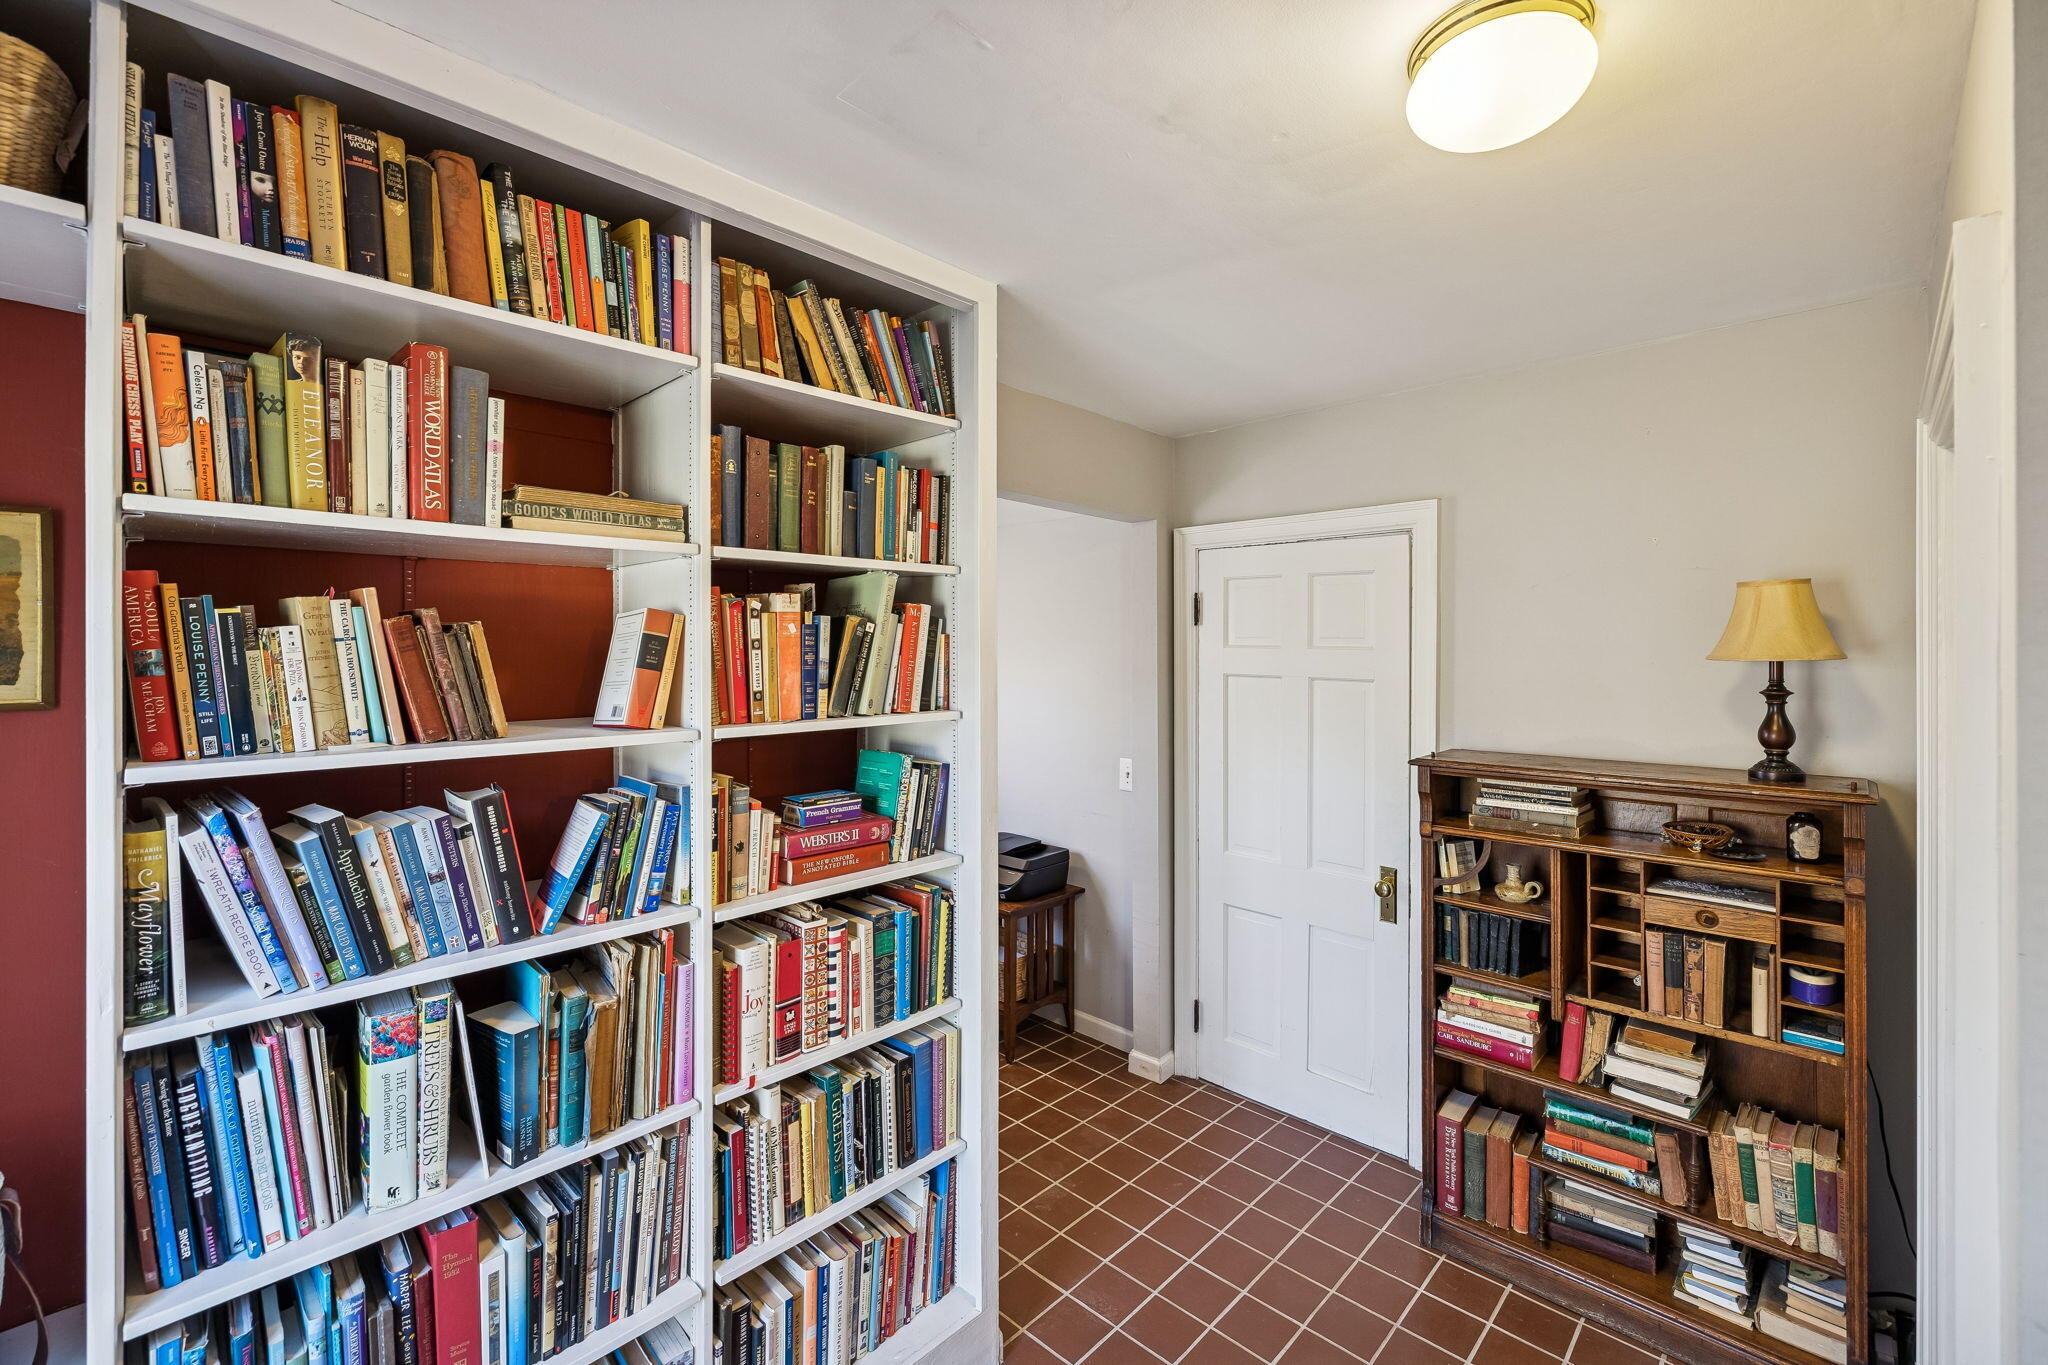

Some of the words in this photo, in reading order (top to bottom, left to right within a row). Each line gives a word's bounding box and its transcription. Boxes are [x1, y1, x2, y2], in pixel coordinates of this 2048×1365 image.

[126, 65, 137, 101] STUART
[126, 103, 137, 136] LITTLE
[254, 109, 264, 129] Joyce
[317, 116, 327, 133] The
[257, 131, 265, 149] Carol
[310, 132, 330, 167] Help
[344, 133, 377, 148] HERMAN
[349, 140, 375, 153] WOUK
[258, 151, 266, 170] Oates
[315, 178, 327, 231] STOCKETT
[324, 180, 334, 231] KATHRYN
[501, 199, 509, 218] THE
[506, 190, 515, 212] GIRL
[261, 208, 270, 247] Mudwoman
[502, 222, 514, 248] TRAIN
[543, 225, 553, 256] SCHWAB
[526, 233, 542, 281] CUMBERLANDS
[661, 245, 669, 278] LOUISE
[510, 260, 520, 295] HAWKINS
[663, 281, 671, 314] PENNY
[122, 326, 139, 383] BEGINNING
[833, 346, 847, 381] TYLER
[193, 364, 204, 395] Celeste
[128, 383, 142, 416] CHESS
[194, 397, 204, 411] Ng
[130, 417, 143, 444] PLAY
[303, 388, 323, 489] ELEANOR
[424, 400, 441, 458] WORLD
[424, 459, 441, 510] ATLAS
[514, 502, 567, 520] GOODE'S
[573, 507, 613, 525] WORLD
[618, 513, 652, 528] ATLAS
[124, 586, 144, 647] AMERICA
[167, 596, 177, 607] On
[303, 611, 330, 622] Grapes
[339, 602, 347, 615] THE
[909, 608, 920, 617] Me
[144, 600, 157, 637] SOUL
[169, 607, 182, 651] Grandma's
[307, 628, 332, 637] Wrath
[189, 615, 204, 659] LOUISE
[341, 617, 352, 656] CAROLINA
[908, 621, 917, 658] Katharine
[176, 651, 185, 673] Porch
[248, 654, 260, 691] Brendan
[295, 659, 304, 683] PLAYING
[195, 662, 211, 704] PENNY
[346, 657, 358, 701] HOUSEWIFE
[905, 659, 914, 697] Hepburn
[141, 681, 157, 733] MEACHAM
[151, 694, 165, 715] JON
[298, 721, 308, 748] GRISHAM
[594, 815, 606, 835] JOAN
[619, 807, 628, 827] KAREN
[670, 810, 679, 827] PAT
[805, 808, 830, 818] French
[830, 803, 862, 815] Grammar
[440, 820, 452, 841] MARY
[486, 805, 501, 845] MOONFLOWER
[494, 845, 507, 872] MURDERS
[614, 827, 623, 847] WHITE
[800, 831, 850, 850] WEBSTER'S
[851, 829, 859, 839] II
[127, 846, 164, 855] NATHANIEL
[128, 854, 163, 863] PHILBRICK
[445, 841, 459, 868] PETERS
[579, 837, 595, 865] DIDION
[662, 829, 675, 868] CONROY
[819, 859, 830, 867] NEW
[830, 854, 855, 864] OXFORD
[254, 828, 283, 886] SOUTHERN
[275, 882, 299, 925] BOUQUETS
[331, 822, 342, 846] WILLIAMS
[338, 848, 365, 909] Appalachia
[802, 863, 842, 875] ANNOTATED
[843, 858, 860, 867] BIBLE
[242, 890, 256, 908] The
[414, 886, 426, 901] MAN
[424, 844, 436, 867] LAMOTT
[439, 902, 452, 928] JONES
[328, 904, 341, 922] MAN
[418, 901, 433, 924] CALLED
[553, 888, 569, 918] NIGHTS
[131, 868, 162, 974] Mayflower
[209, 870, 234, 913] WREATH
[229, 912, 253, 948] RECIPE
[246, 949, 265, 978] BOOK
[247, 905, 267, 934] Scented
[300, 888, 318, 925] CHARLESTON
[315, 930, 330, 959] SAVANNAH
[334, 921, 349, 946] CALLED
[426, 925, 437, 940] OVE
[260, 932, 275, 955] Room
[342, 946, 355, 962] OVE
[742, 990, 765, 1015] joy
[423, 1025, 440, 1082] TREES
[1437, 1031, 1454, 1042] CARL
[1456, 1036, 1492, 1051] SANDBURG
[203, 1045, 216, 1091] SAMPLERS
[439, 1041, 447, 1072] HILLIER
[141, 1082, 150, 1097] THE
[158, 1077, 168, 1099] Sewing
[221, 1070, 230, 1094] COLOR
[381, 1073, 391, 1104] garden
[396, 1069, 407, 1091] THE
[143, 1098, 154, 1124] QUILTS
[177, 1083, 195, 1130] VOGUE
[225, 1098, 234, 1118] BOOK
[439, 1074, 447, 1121] GARDENER'S
[382, 1105, 391, 1131] flower
[397, 1094, 408, 1151] COMPLETE
[421, 1098, 439, 1166] SHRUBS
[525, 1115, 533, 1146] KRISTIN
[831, 1098, 842, 1162] GREENS
[382, 1132, 391, 1156] book
[518, 1116, 526, 1151] HANNAH
[149, 1134, 161, 1175] TENNESSEE
[184, 1132, 211, 1198] KNITTING
[231, 1134, 242, 1167] EGYPTIAN
[248, 1099, 263, 1154] nutritious
[257, 1154, 272, 1211] DELICIOUS
[1564, 1152, 1605, 1175] American
[1607, 1165, 1627, 1181] Falls
[237, 1170, 249, 1213] MYTHOLOGY
[667, 1163, 675, 1203] ARCHITECTURE
[178, 1228, 190, 1260] SINGER
[672, 1204, 683, 1256] BUNGALOW
[442, 1252, 459, 1261] The
[442, 1256, 473, 1272] Hymnal
[400, 1273, 410, 1312] HARPER
[401, 1314, 411, 1331] LEE
